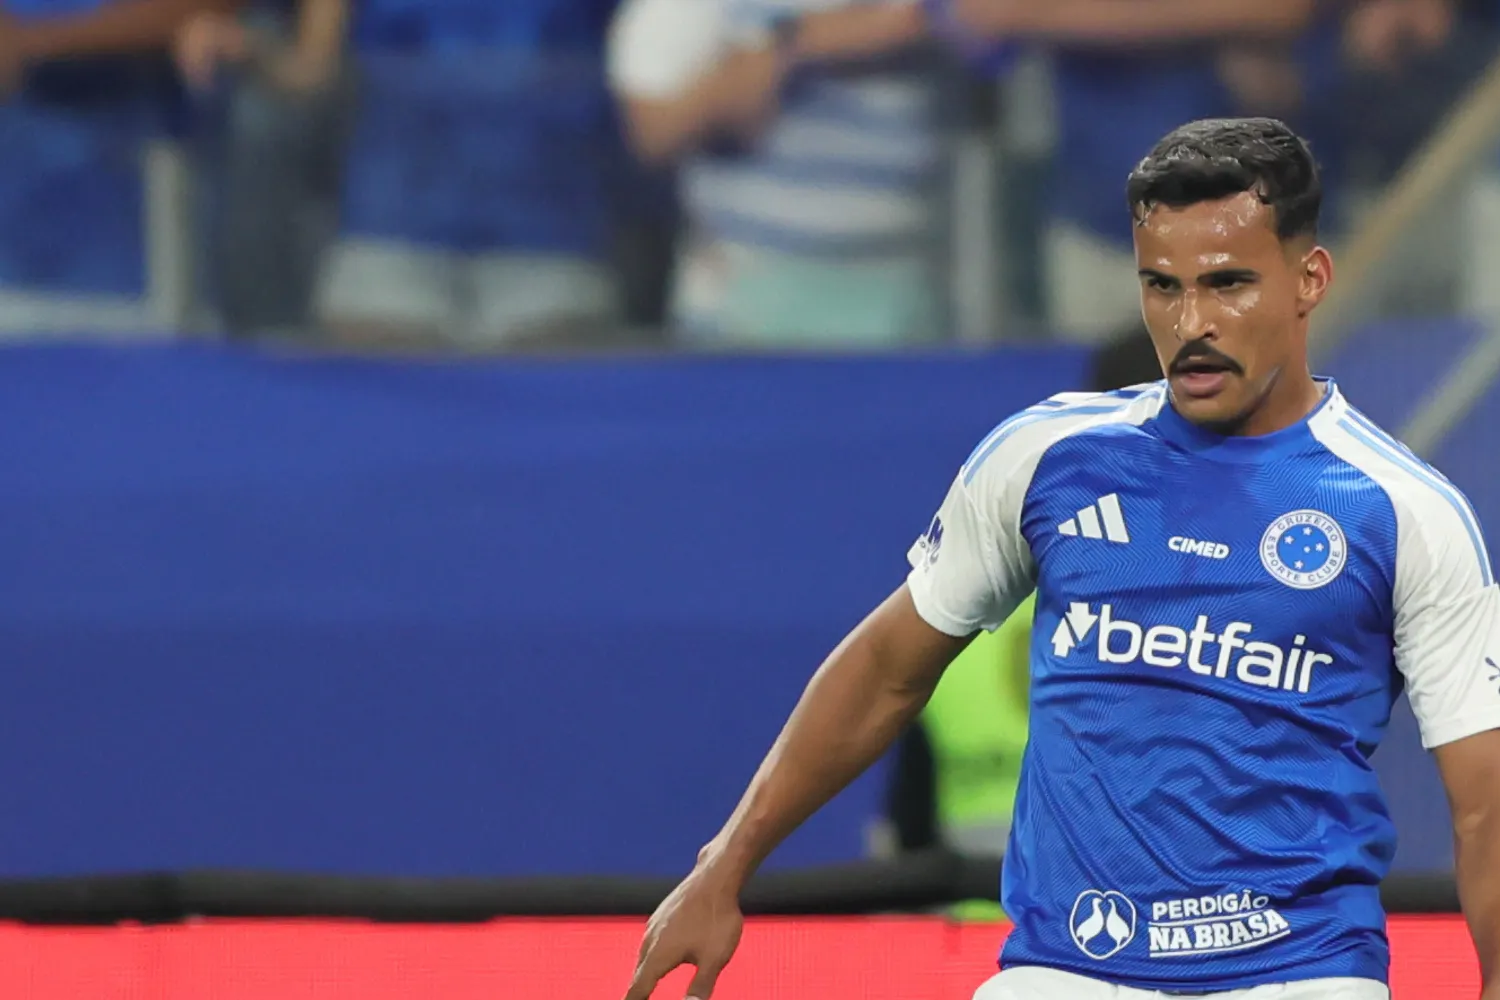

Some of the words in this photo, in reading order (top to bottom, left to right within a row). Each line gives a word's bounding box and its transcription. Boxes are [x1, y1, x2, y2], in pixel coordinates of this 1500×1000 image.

[1277, 515, 1339, 542] CRUZEIRO
[1167, 535, 1230, 560] CIMED
[1266, 535, 1300, 581] ESPORTE
[1307, 550, 1340, 583] CLUBE
[1097, 603, 1333, 694] betfair
[1152, 889, 1269, 921] PERDIGÃO
[1148, 926, 1191, 951] NA
[1194, 908, 1289, 949] BRASA
